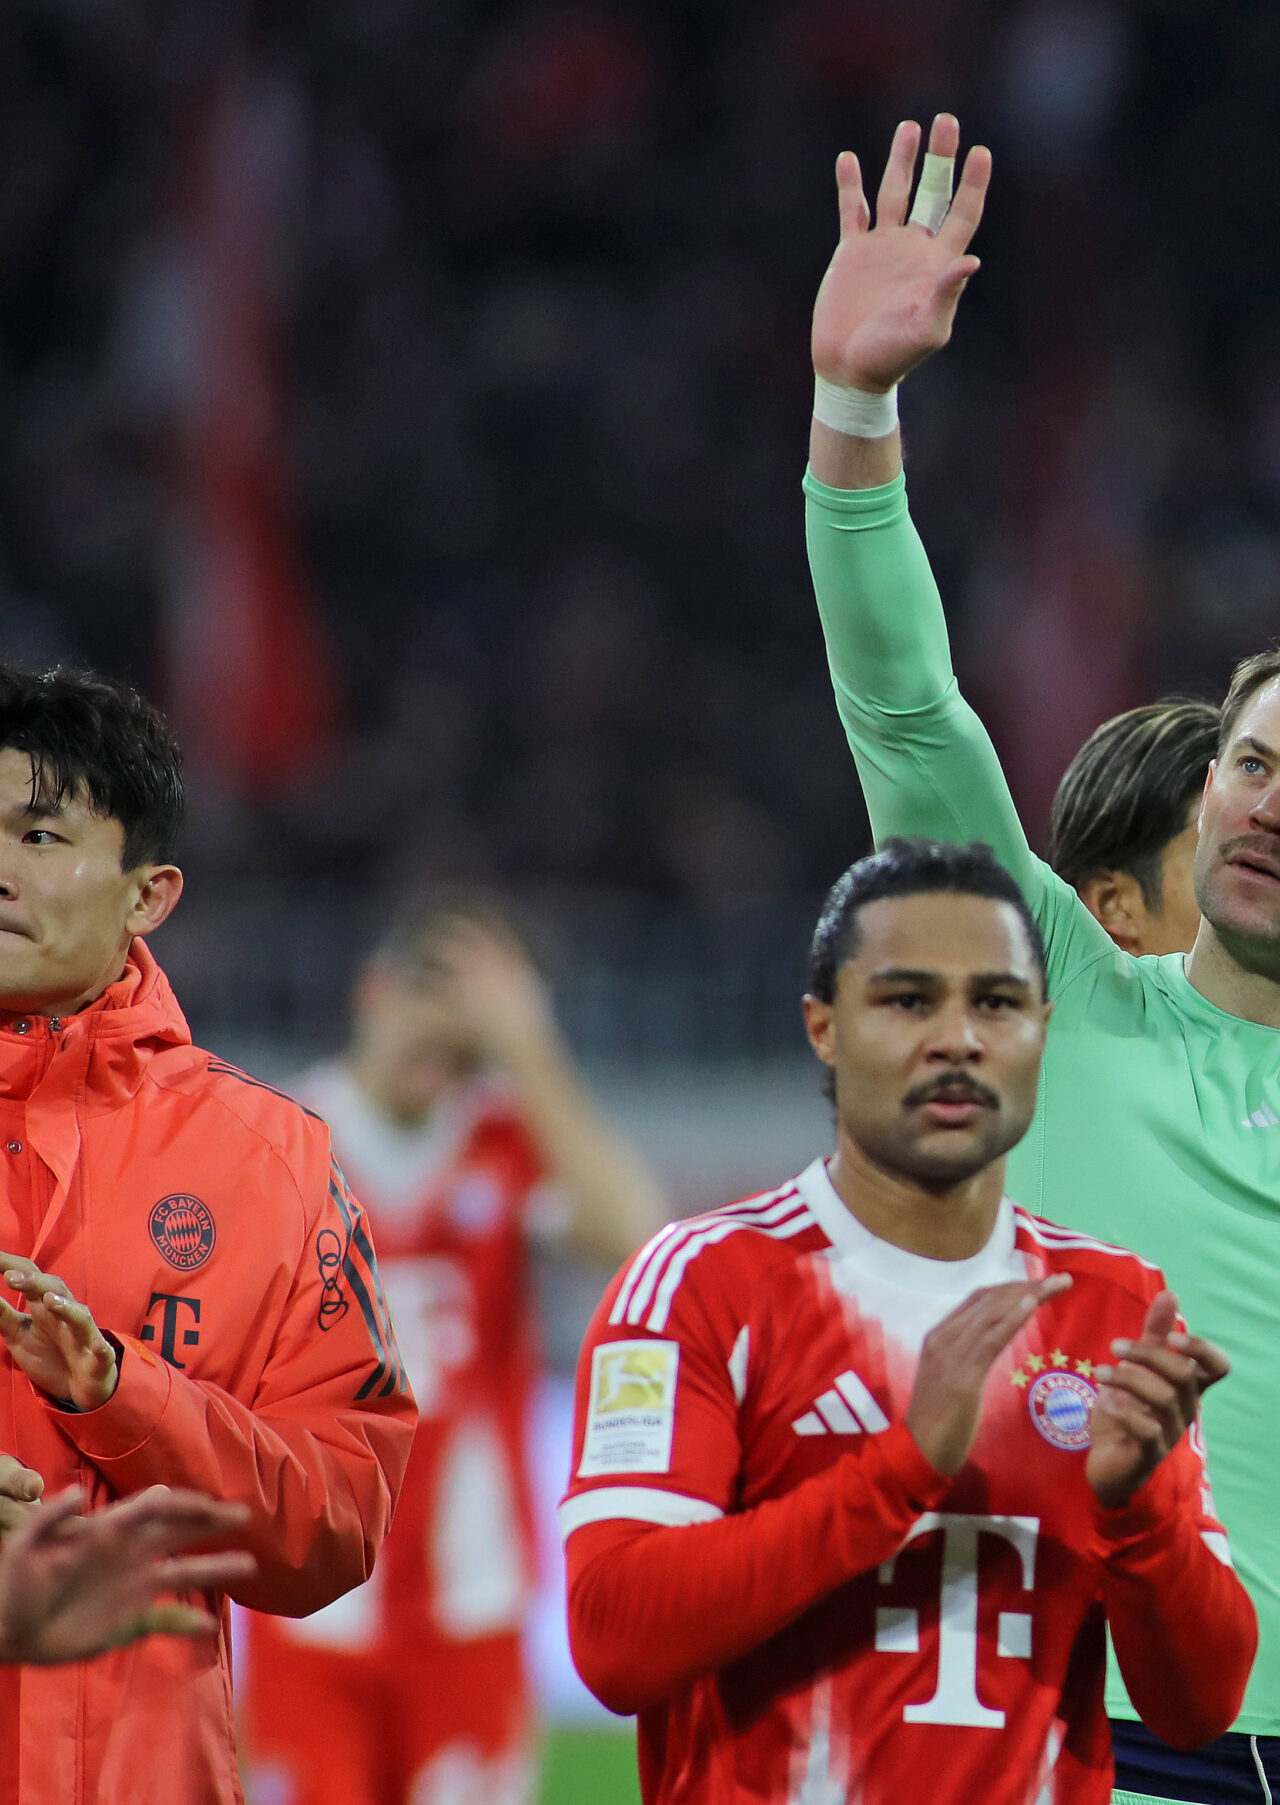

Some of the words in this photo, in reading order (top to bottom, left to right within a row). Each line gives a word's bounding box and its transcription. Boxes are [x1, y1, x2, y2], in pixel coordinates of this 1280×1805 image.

[155, 1207, 168, 1223] FC
[168, 1198, 211, 1231] BAYERN
[141, 1292, 200, 1369] T
[875, 1512, 1040, 1729] T
